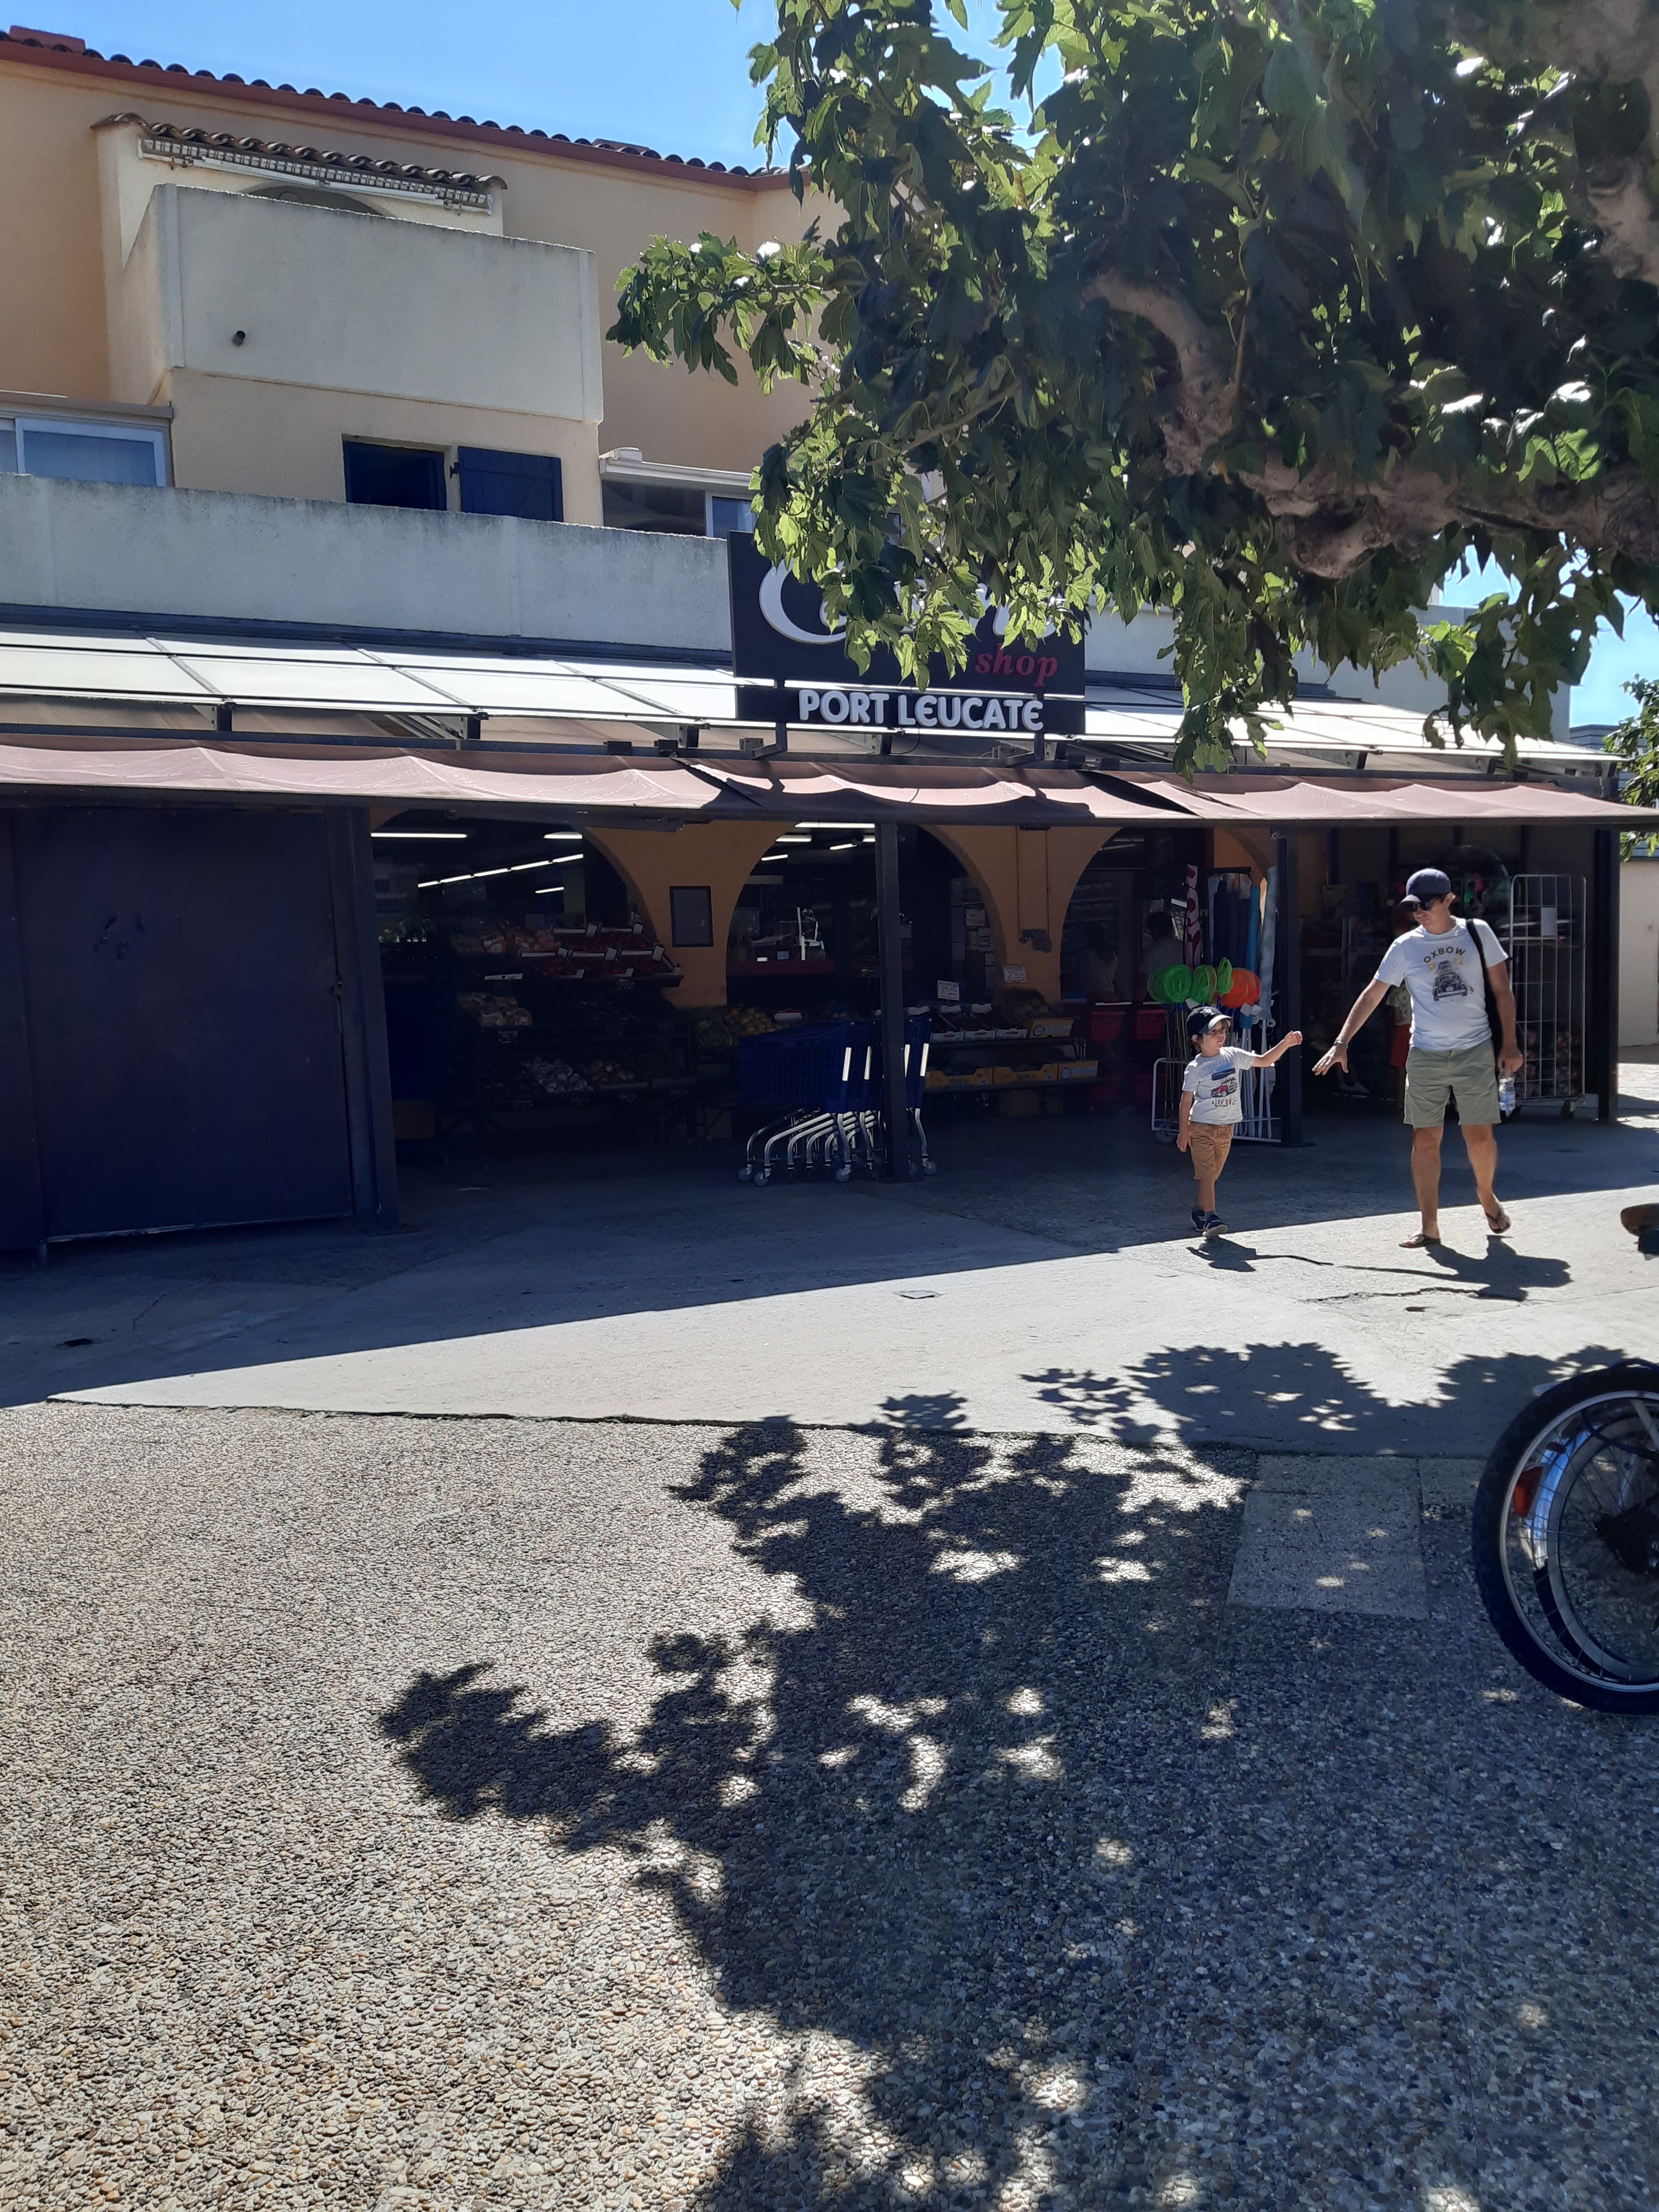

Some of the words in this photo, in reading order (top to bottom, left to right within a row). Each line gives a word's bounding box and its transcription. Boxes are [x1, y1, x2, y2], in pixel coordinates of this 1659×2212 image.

[974, 643, 1058, 687] shop
[799, 689, 890, 724] PORT
[897, 694, 1044, 731] LEUCATE
[1423, 946, 1466, 963] OXBOW
